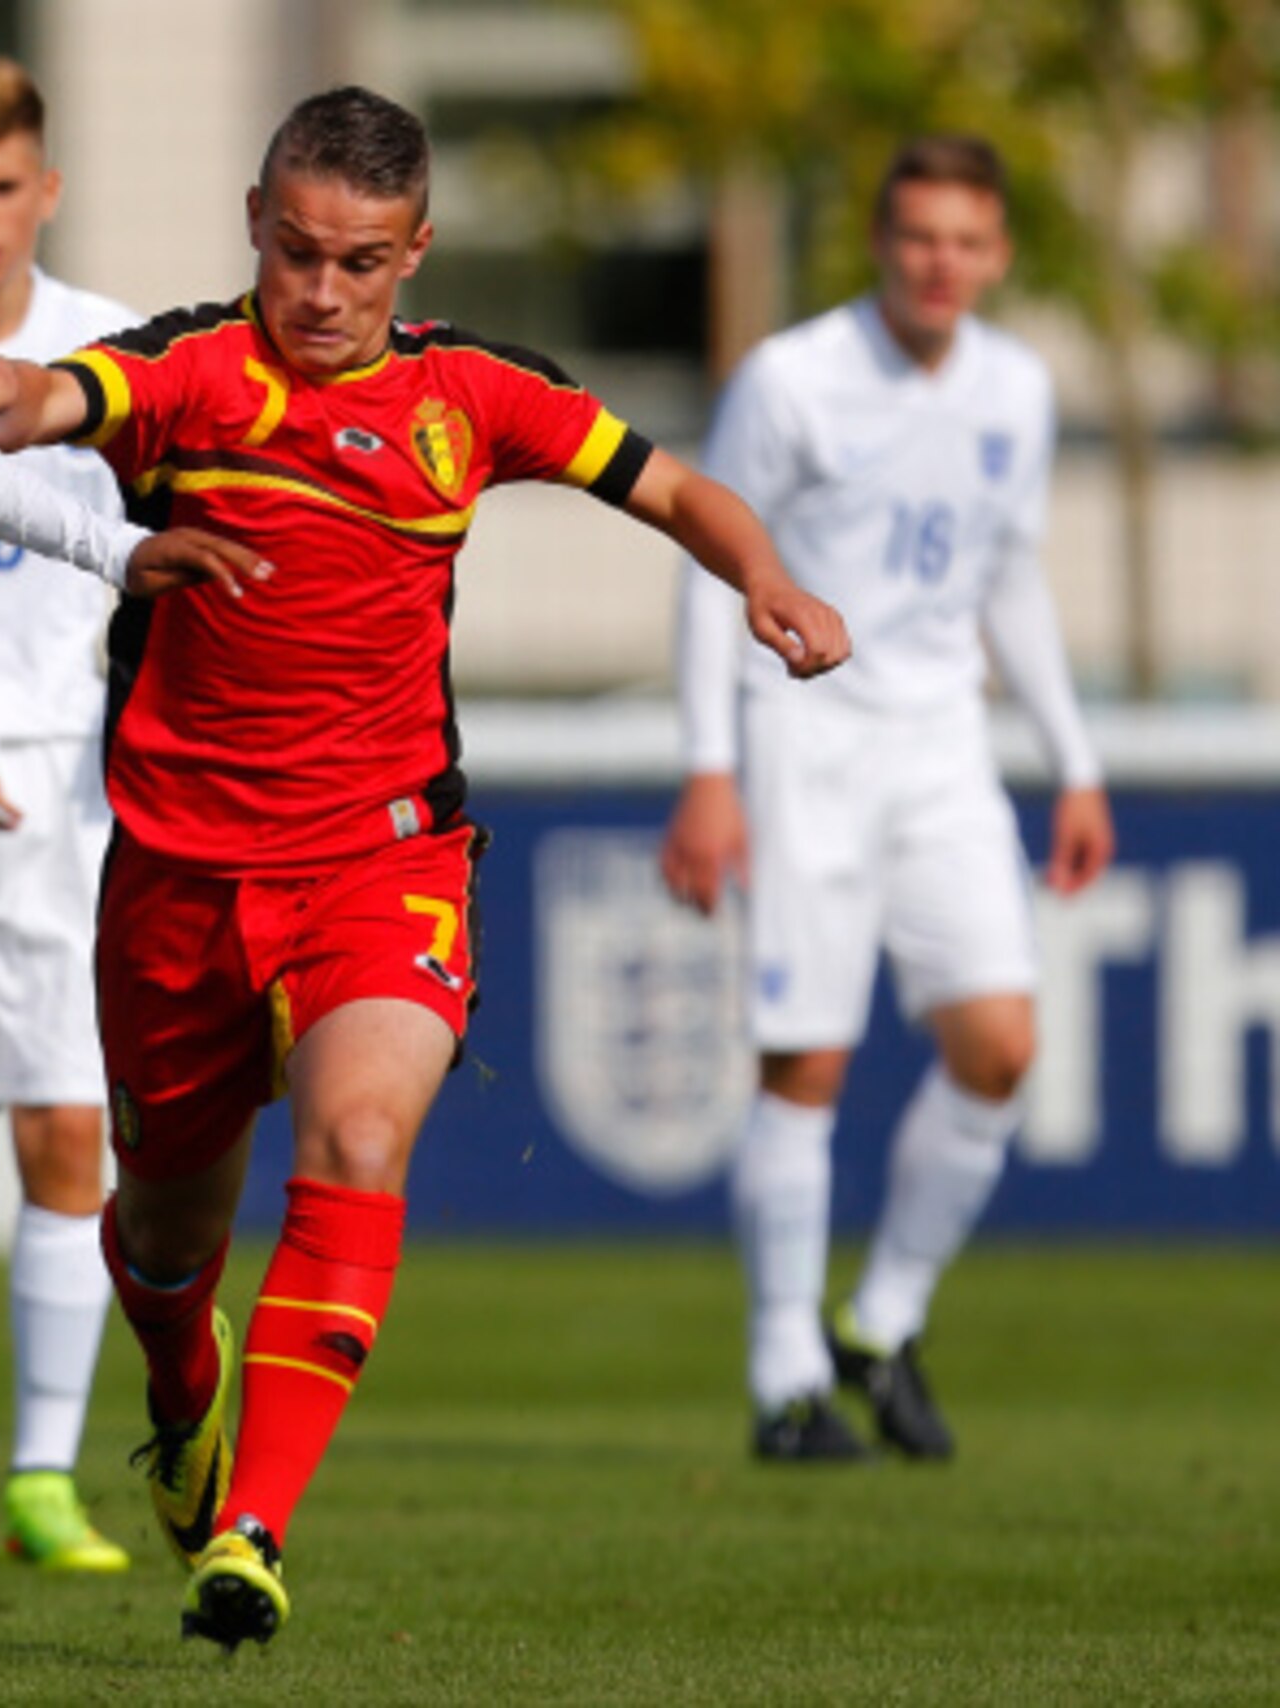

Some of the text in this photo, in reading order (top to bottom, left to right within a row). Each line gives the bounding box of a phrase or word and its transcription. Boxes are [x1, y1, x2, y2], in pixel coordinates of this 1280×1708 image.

[243, 354, 289, 446] 7
[883, 498, 955, 584] 16
[402, 893, 458, 965] 7
